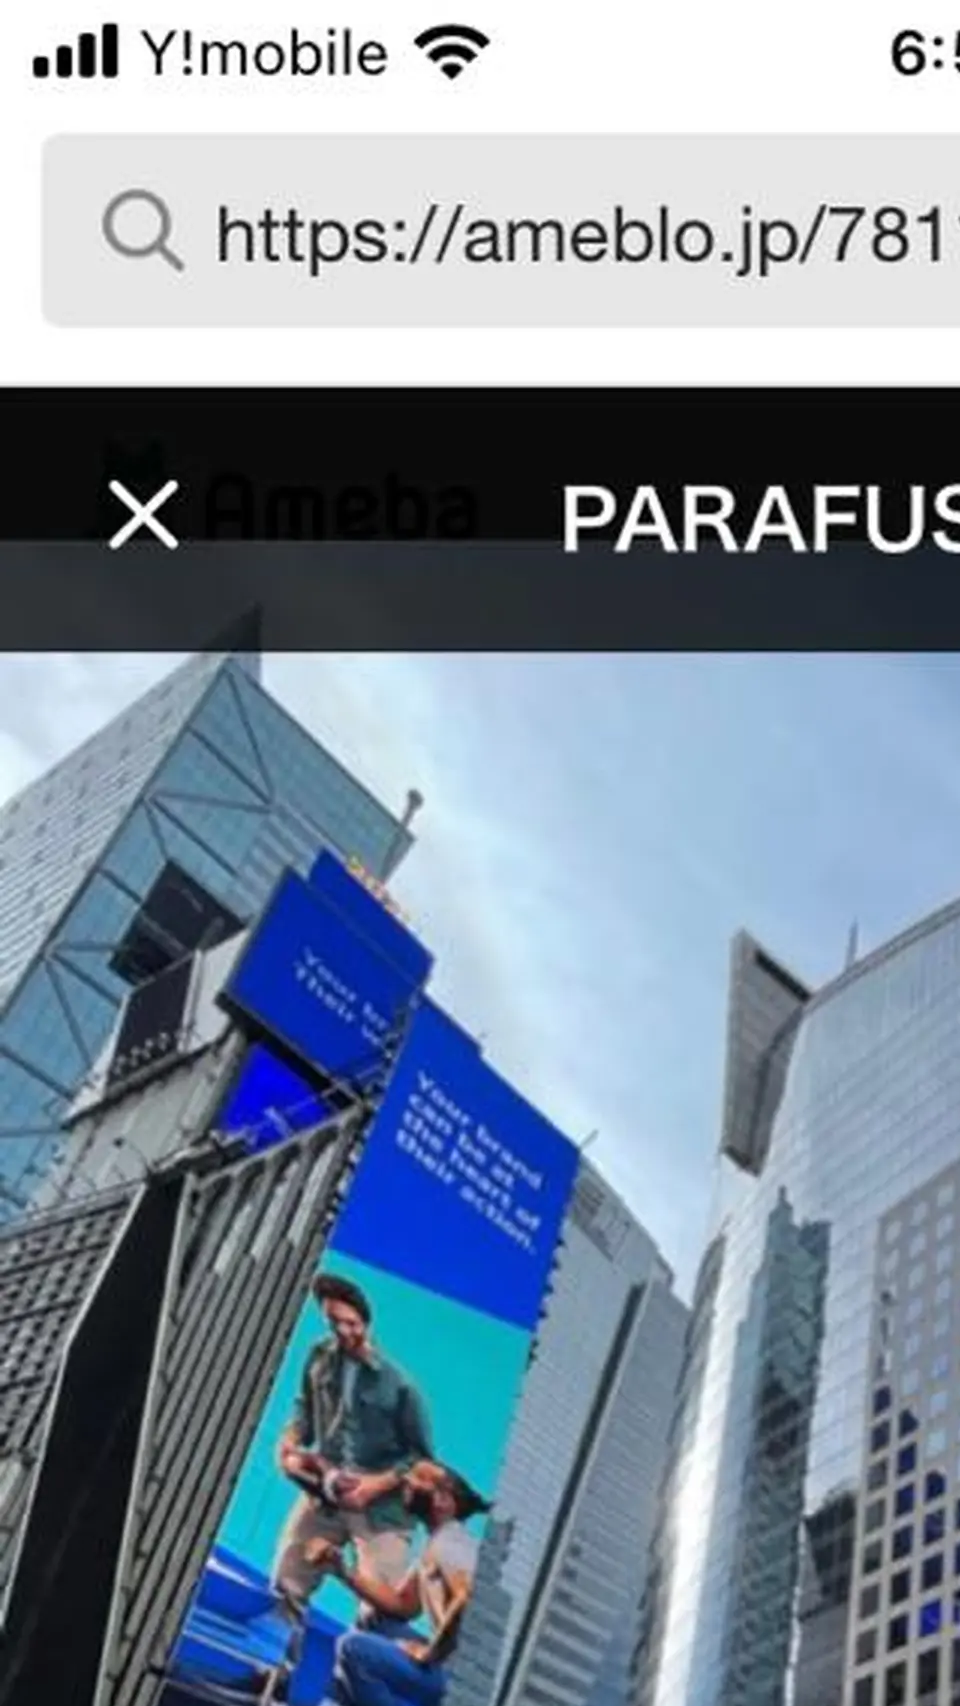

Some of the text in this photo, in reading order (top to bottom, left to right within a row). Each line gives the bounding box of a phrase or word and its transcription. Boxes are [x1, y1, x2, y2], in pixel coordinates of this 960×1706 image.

[395, 1127, 455, 1185] their
[402, 1108, 444, 1154] the
[449, 1147, 513, 1211] heart
[417, 1069, 543, 1191] Your brand
